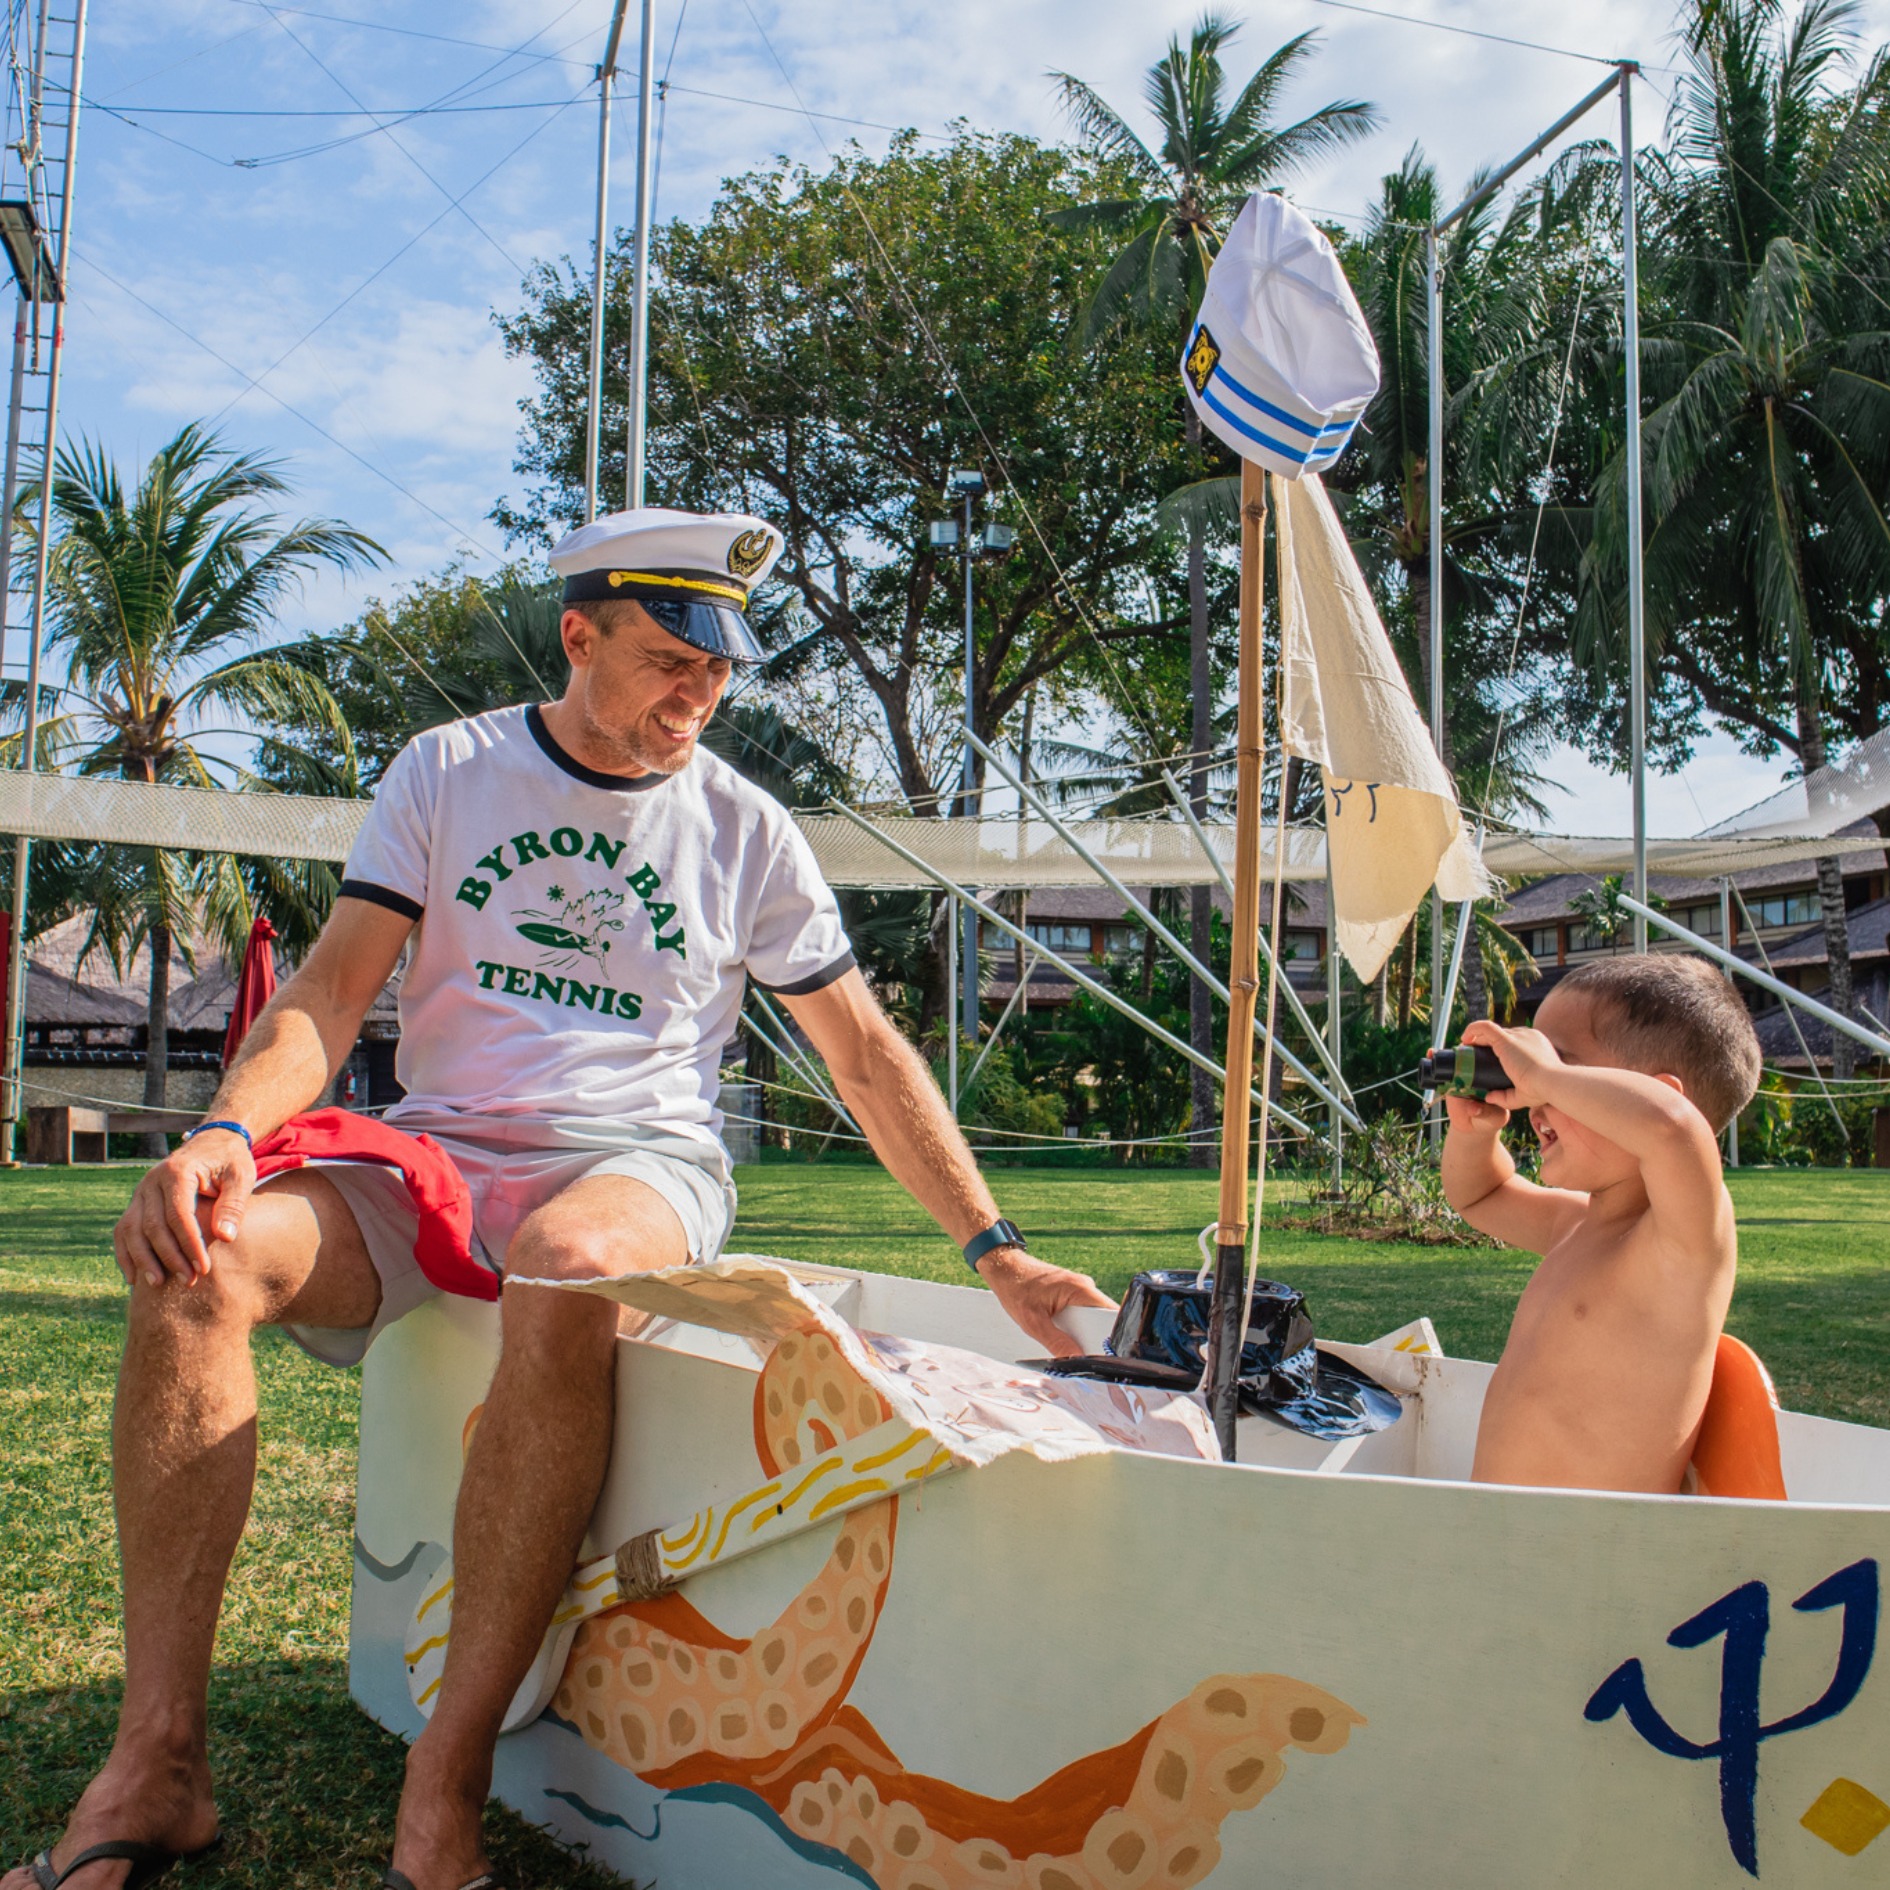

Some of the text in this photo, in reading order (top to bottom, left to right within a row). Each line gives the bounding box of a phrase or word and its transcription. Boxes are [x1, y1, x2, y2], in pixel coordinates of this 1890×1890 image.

[456, 827, 687, 960] BYRON BAY
[476, 960, 643, 1020] TENNIS
